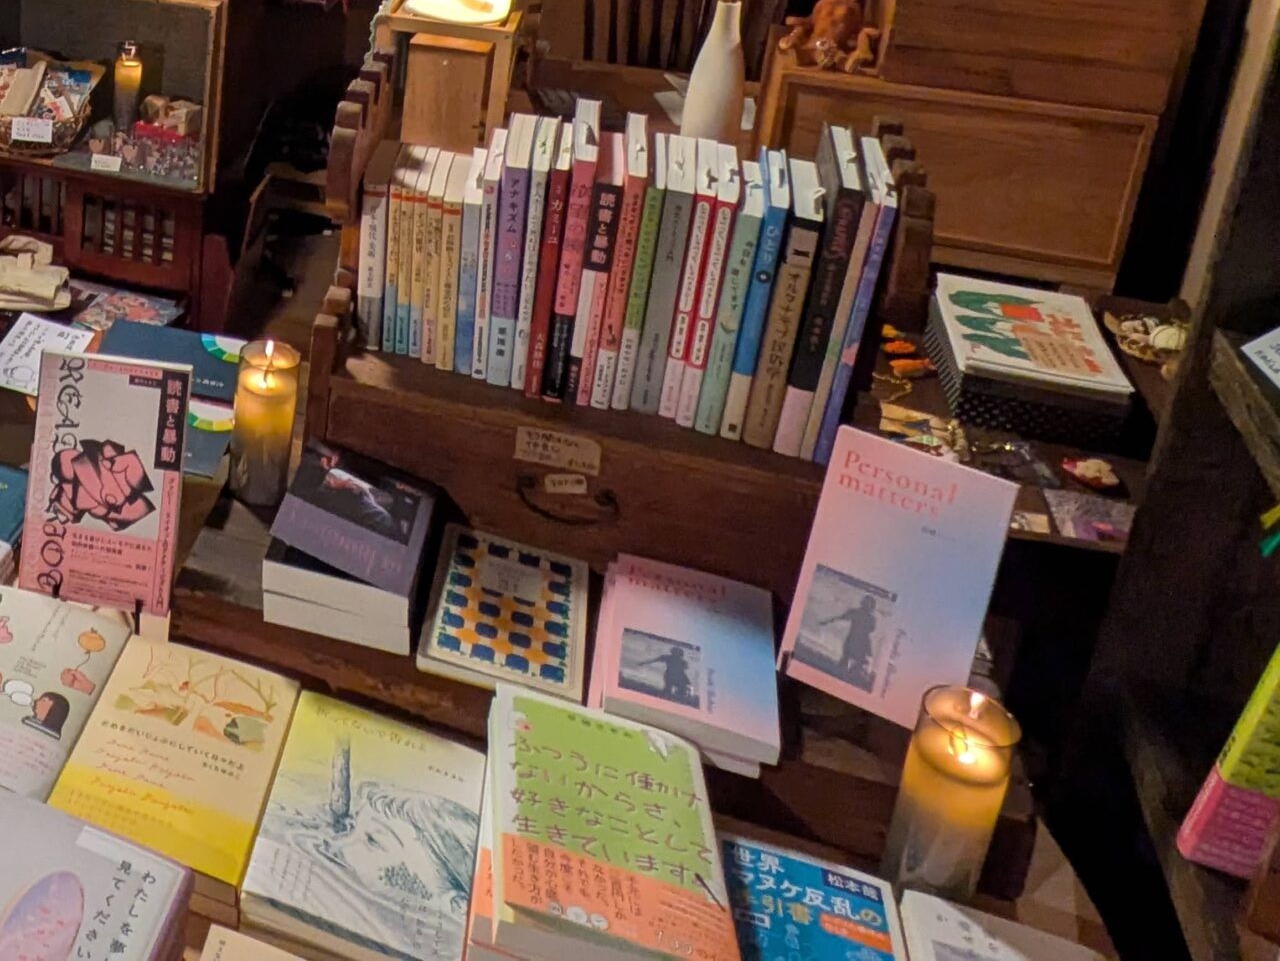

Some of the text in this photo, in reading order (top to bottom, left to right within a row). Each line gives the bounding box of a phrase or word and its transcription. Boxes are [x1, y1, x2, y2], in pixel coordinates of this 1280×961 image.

[505, 177, 521, 235] アナキズム
[837, 469, 942, 519] matters
[843, 449, 961, 505] Personal
[510, 760, 682, 830] ないからさ、
[510, 788, 714, 865] 好きなことして
[76, 859, 133, 960] 見てください
